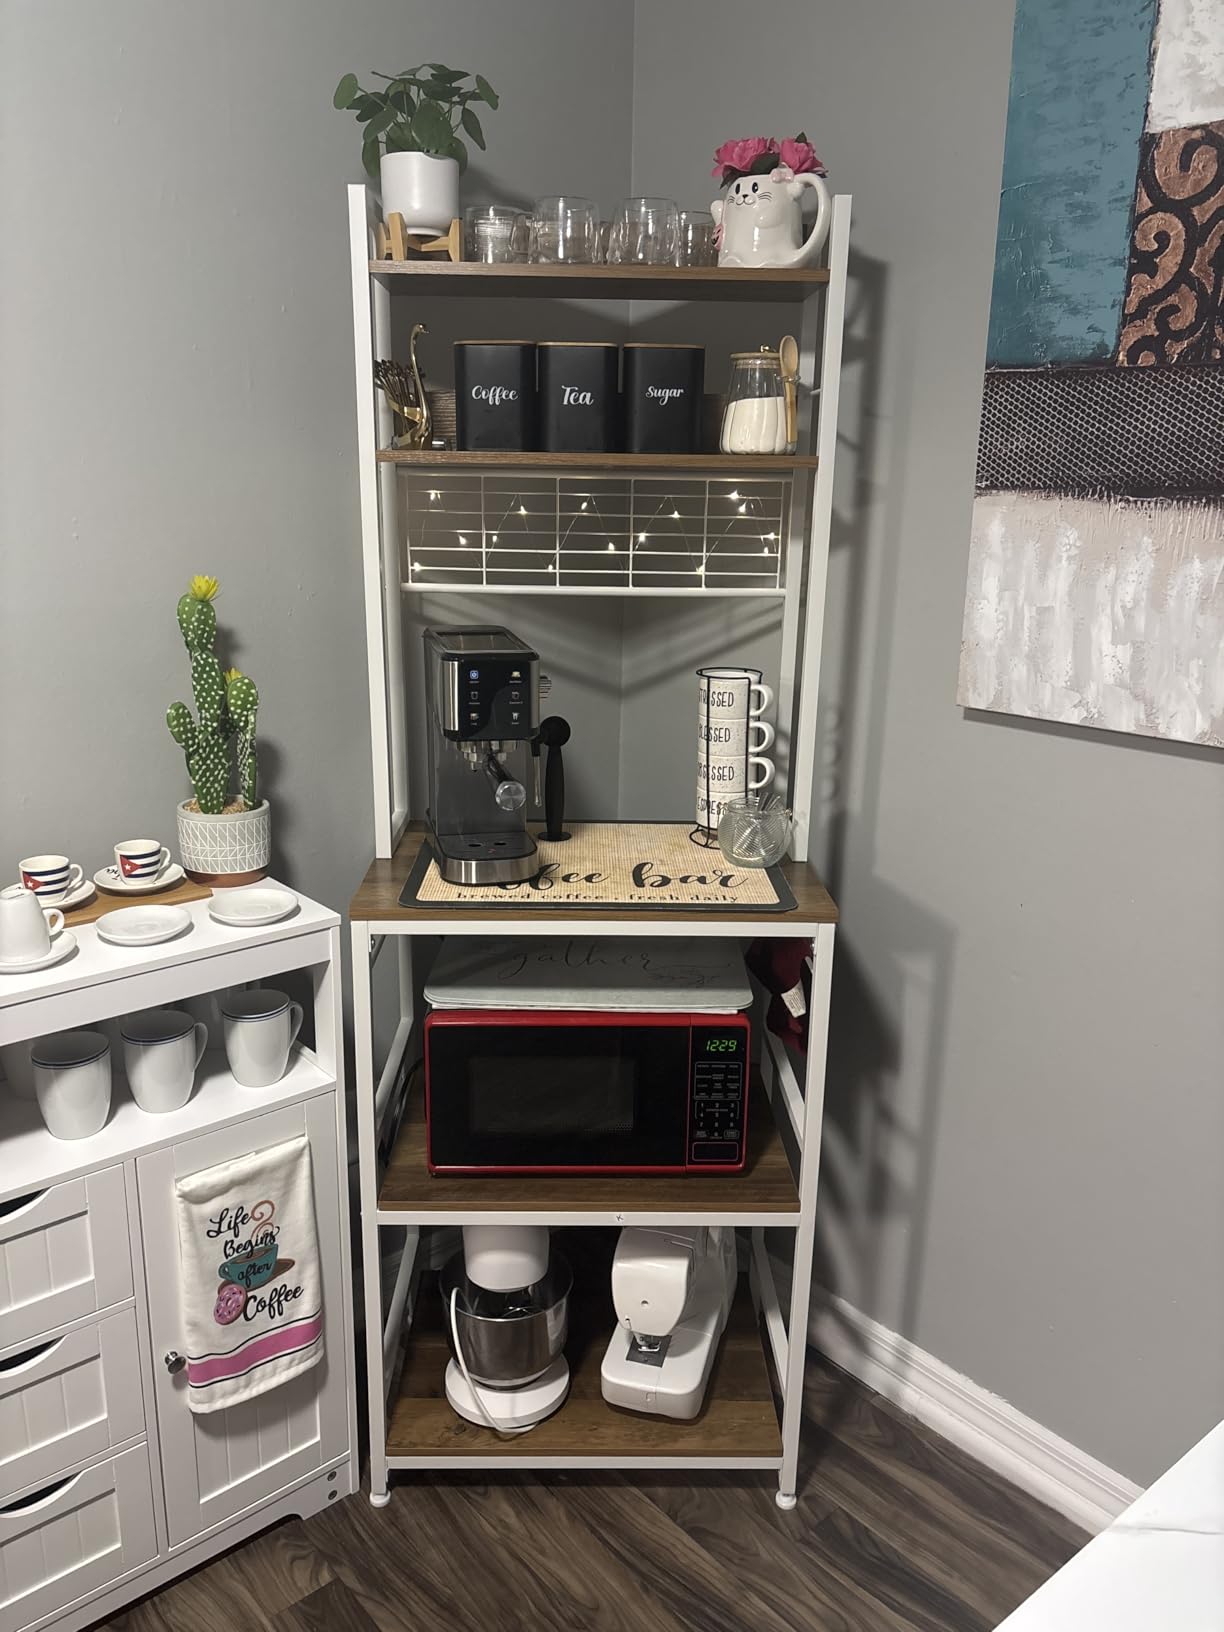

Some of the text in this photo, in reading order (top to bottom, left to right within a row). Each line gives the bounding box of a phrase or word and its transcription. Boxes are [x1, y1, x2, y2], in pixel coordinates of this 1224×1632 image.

[471, 385, 519, 405] Coffee
[561, 385, 594, 406] Tea
[645, 386, 684, 406] Sugar
[632, 862, 749, 888] bar
[690, 894, 738, 903] daily
[500, 940, 652, 980] gather
[206, 1206, 253, 1238] Life
[224, 1226, 280, 1259] Begins
[238, 1262, 272, 1288] after
[243, 1284, 304, 1321] Coffee
